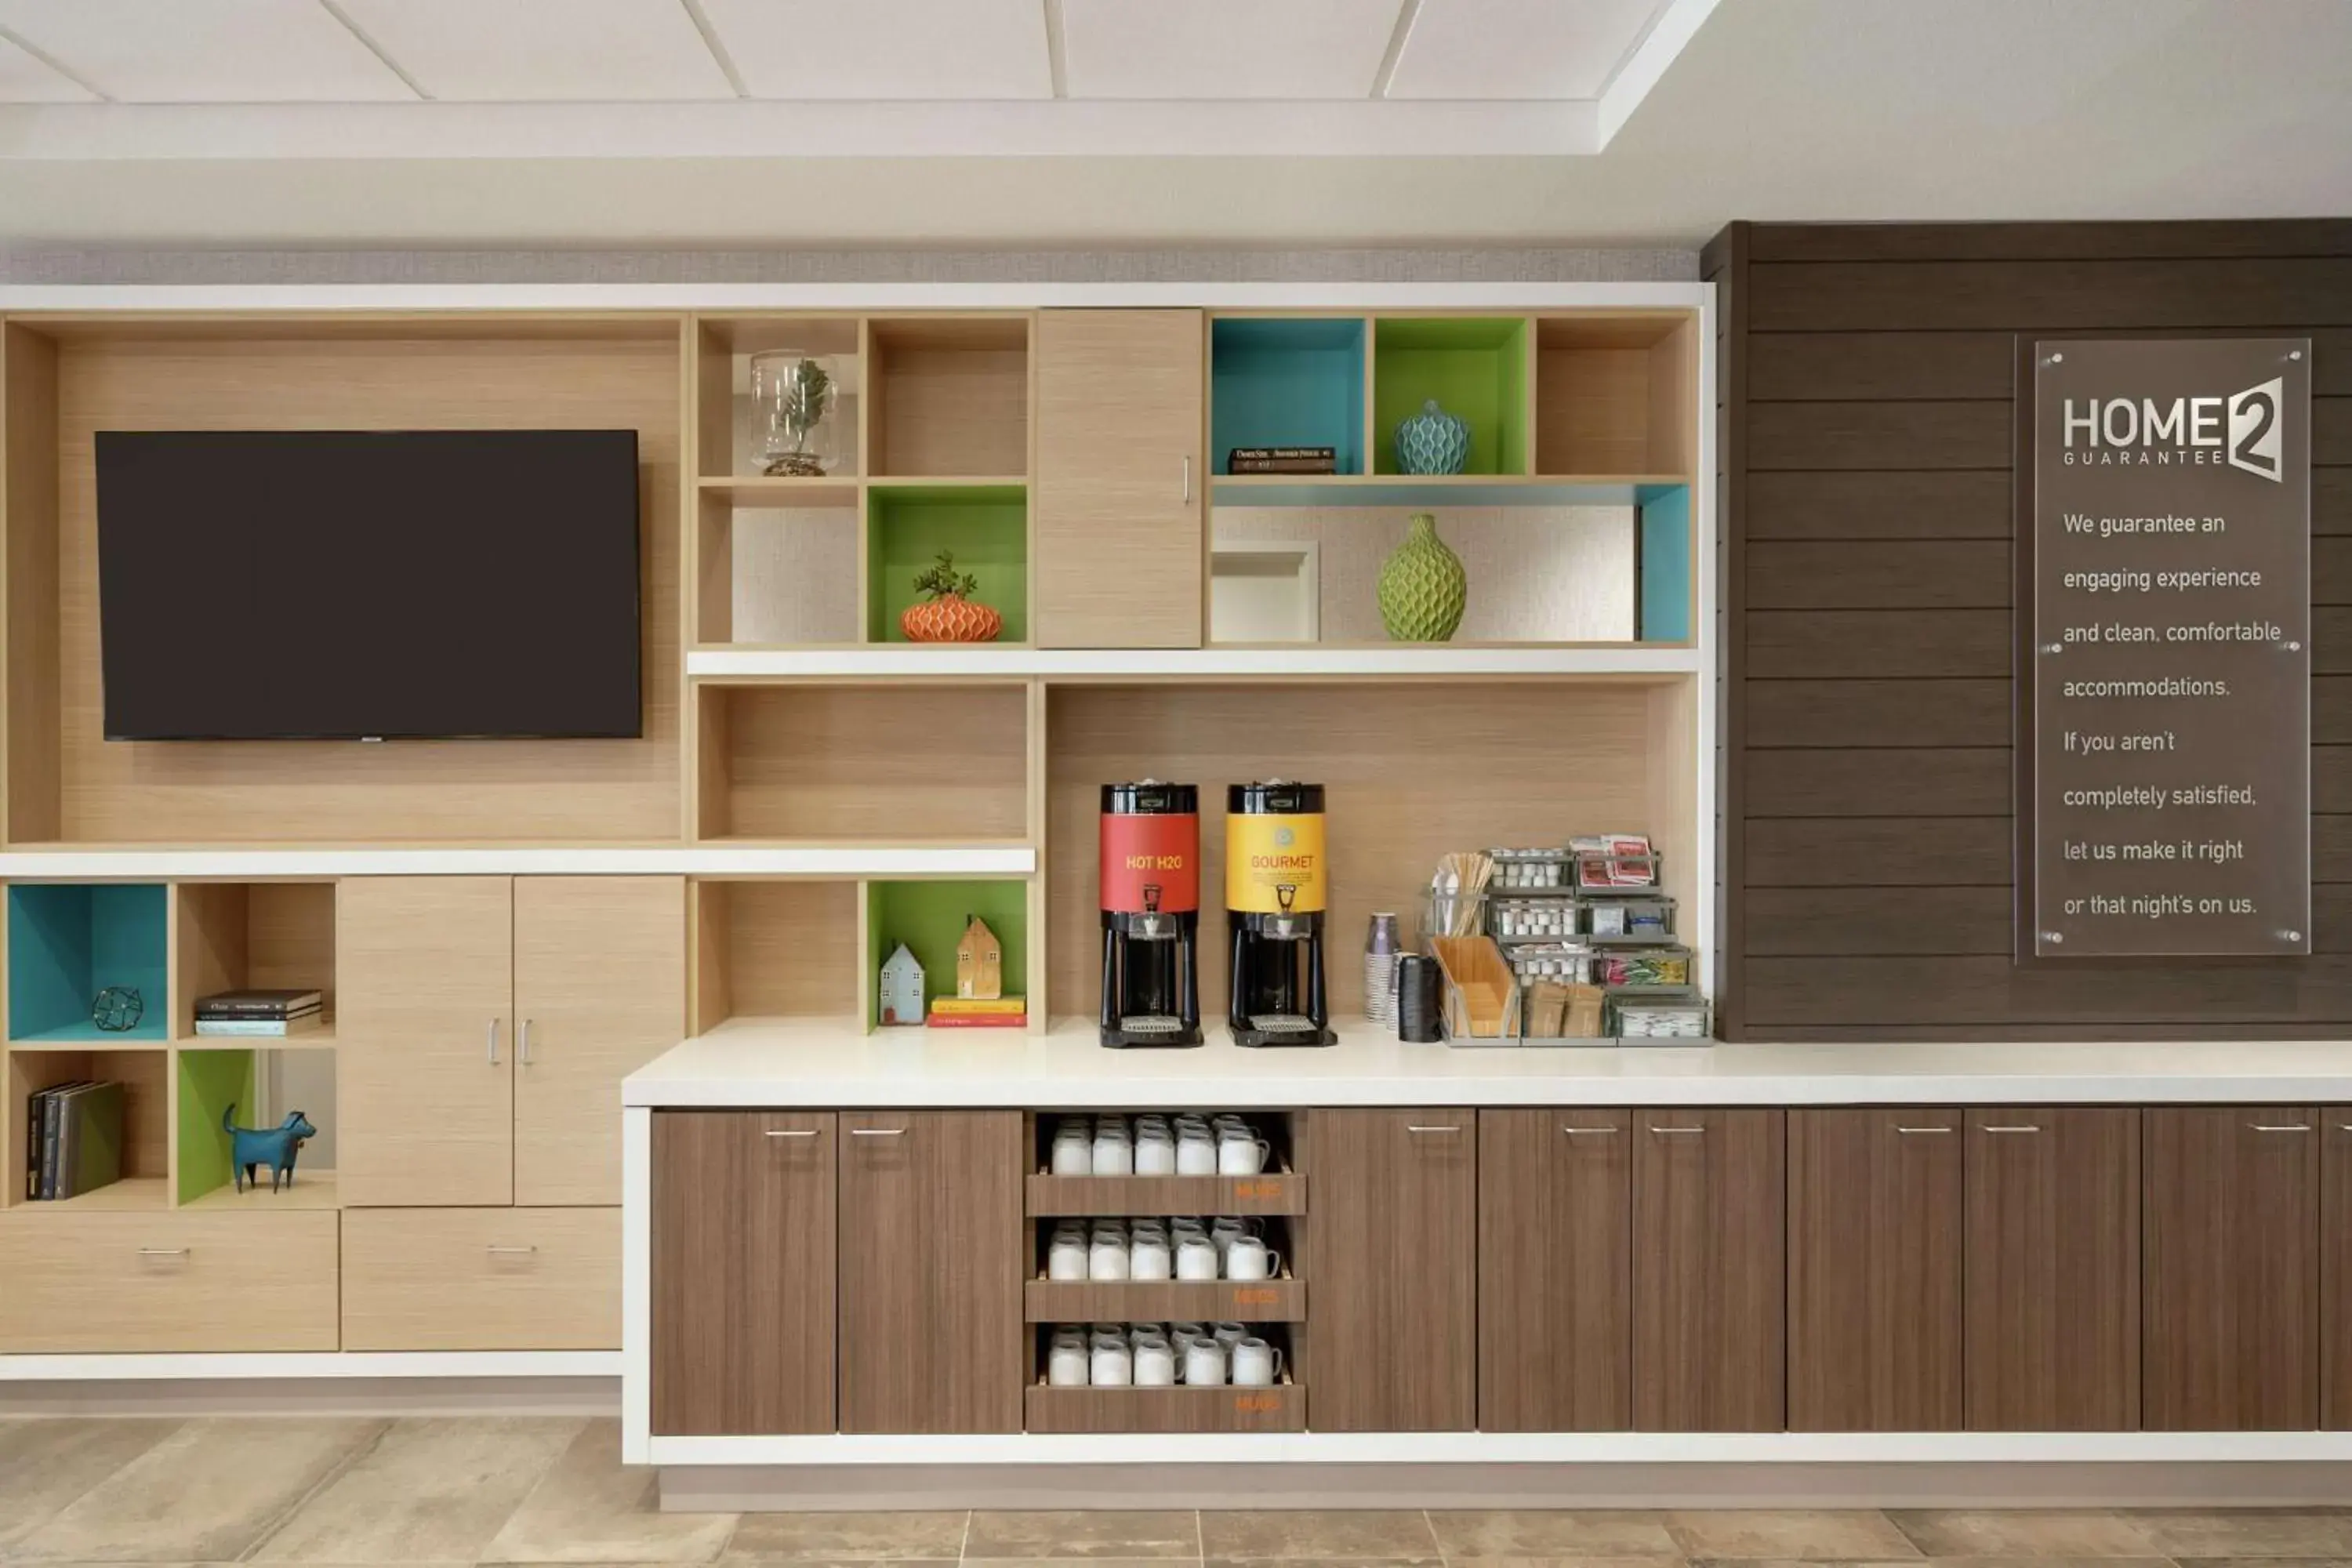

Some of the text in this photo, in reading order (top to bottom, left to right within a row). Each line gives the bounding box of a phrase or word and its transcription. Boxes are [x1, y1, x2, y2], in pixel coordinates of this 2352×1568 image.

[2063, 389, 2277, 474] HOME 2
[2063, 450, 2223, 466] GUARANTEE
[2063, 514, 2225, 538] We guarantee an
[2063, 567, 2262, 593] engaging experience
[2063, 622, 2099, 642] and
[2166, 621, 2281, 641] comfortable
[2063, 677, 2230, 697] accommodations.
[2064, 731, 2077, 751] If
[2082, 735, 2115, 756] you
[2063, 784, 2257, 810] completely satisfied,
[1126, 855, 1153, 869] HOT
[1251, 855, 1314, 869] GOURMET
[2064, 839, 2245, 865] let us make it right
[2064, 898, 2085, 915] or
[2090, 895, 2126, 915] that
[2198, 898, 2223, 914] on
[2229, 898, 2258, 914] us.
